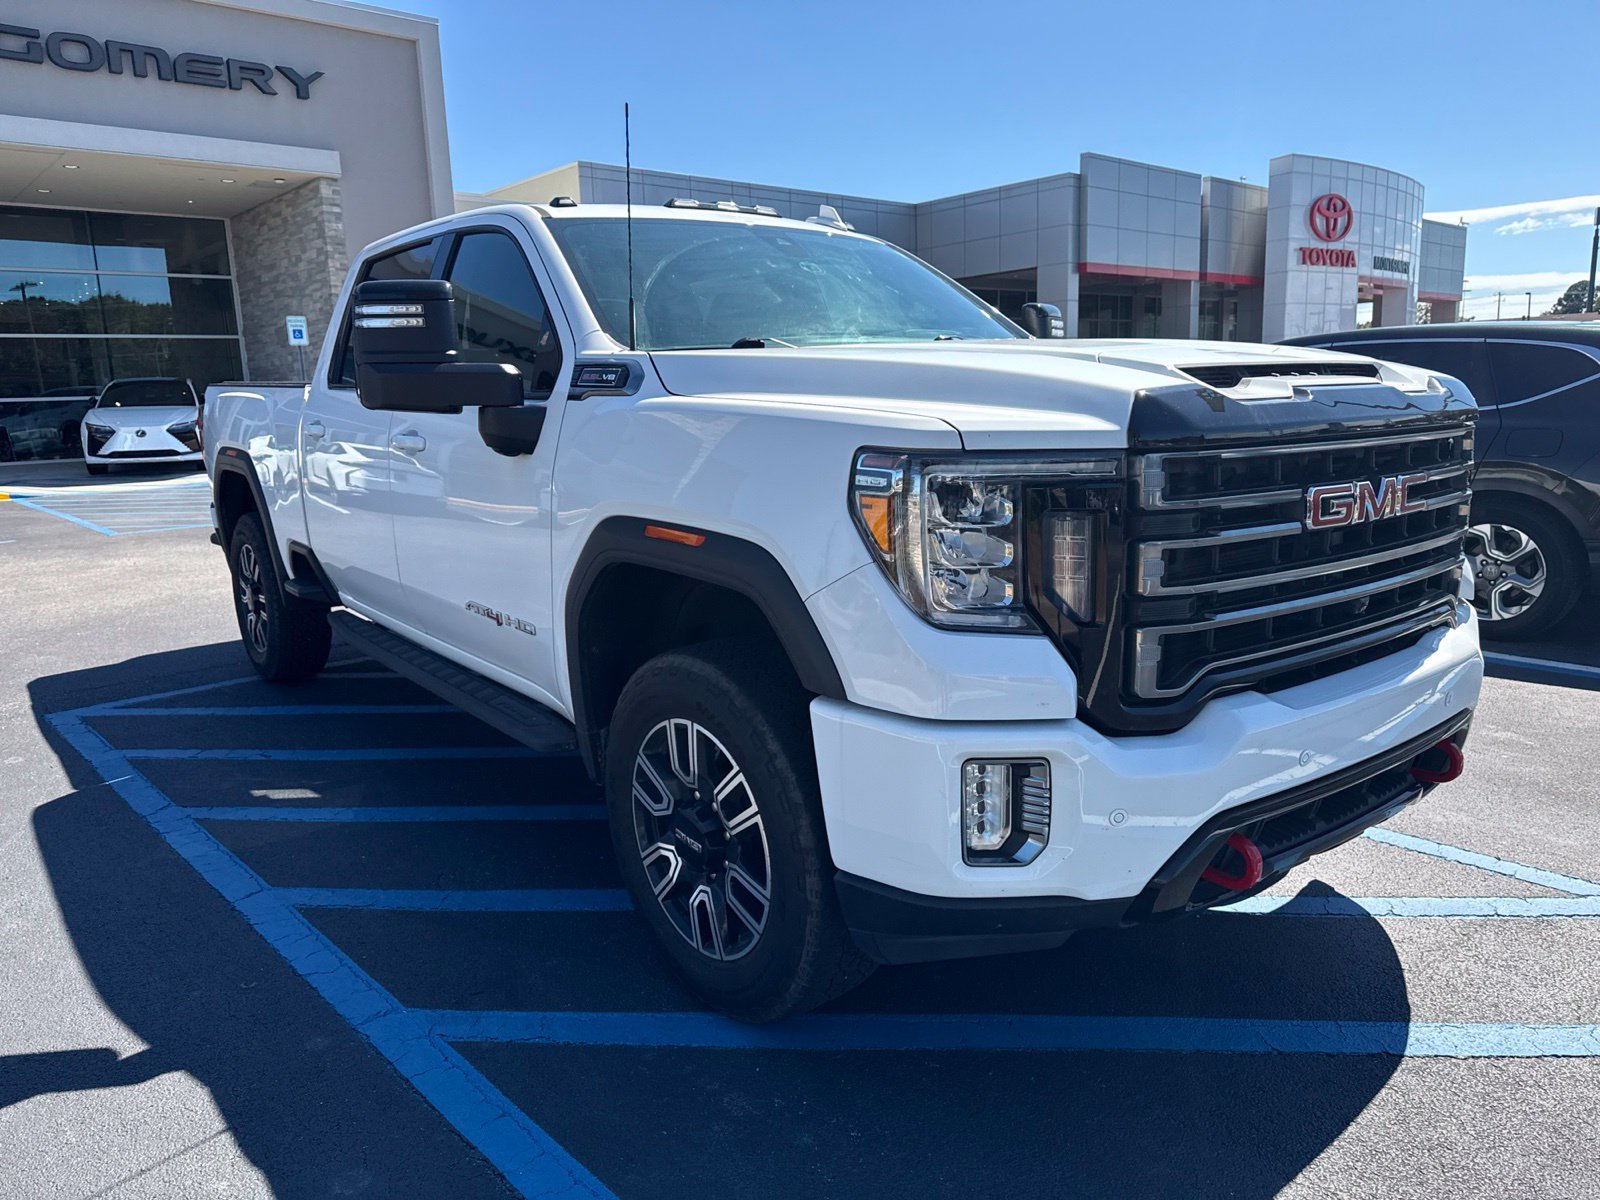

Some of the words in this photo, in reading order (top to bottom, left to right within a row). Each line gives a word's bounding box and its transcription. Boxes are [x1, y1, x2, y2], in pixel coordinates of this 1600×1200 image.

[1299, 247, 1356, 268] TOYOTA
[1305, 473, 1427, 530] GMC
[465, 600, 503, 626] AT4
[504, 614, 537, 636] HD
